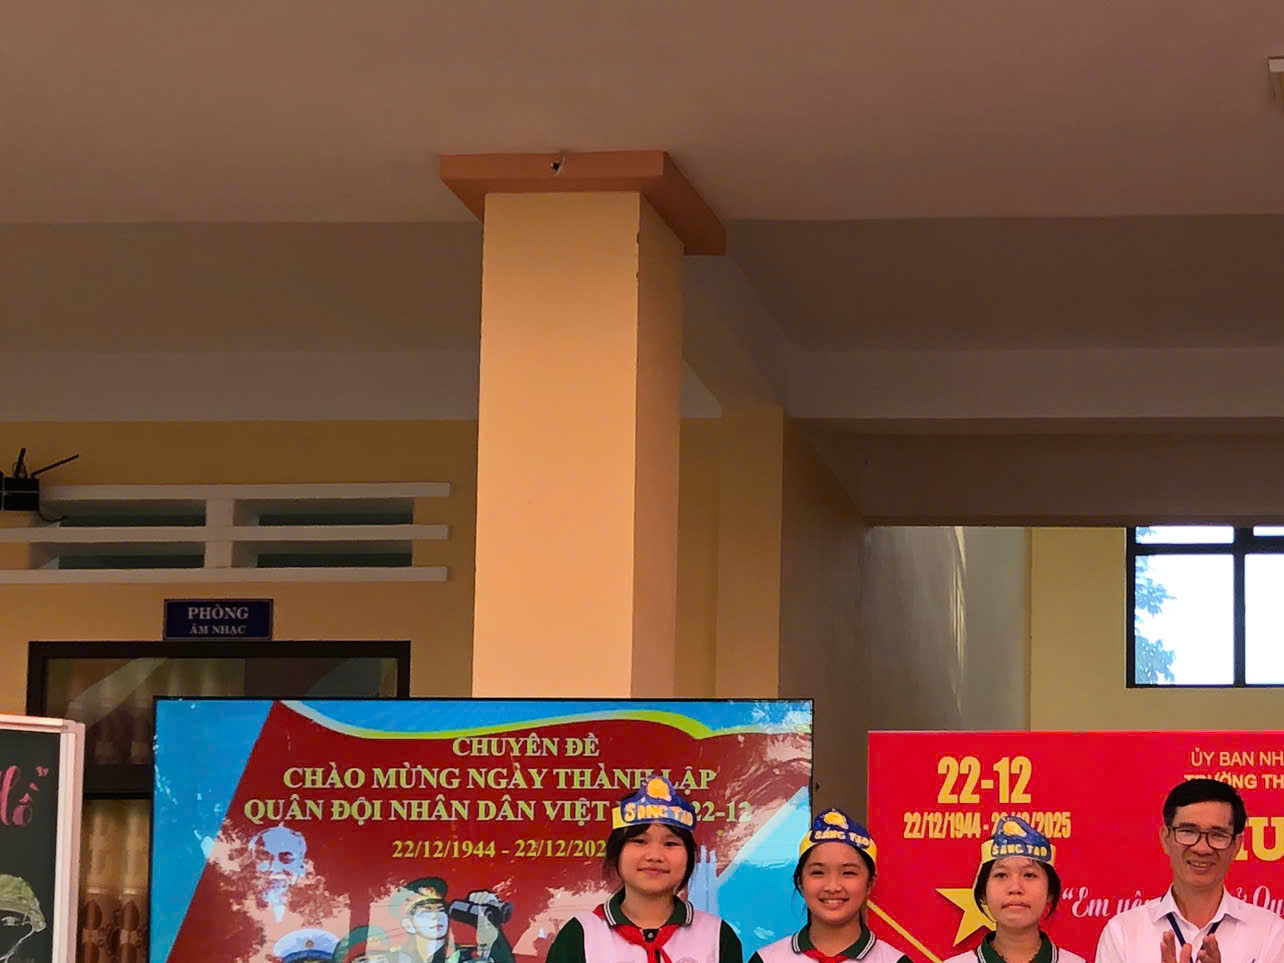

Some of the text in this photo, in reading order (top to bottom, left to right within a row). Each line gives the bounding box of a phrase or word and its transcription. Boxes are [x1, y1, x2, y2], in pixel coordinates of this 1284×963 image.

[188, 604, 248, 620] PHÒNG
[452, 732, 600, 757] CHUYÊN ĐỀ
[1191, 747, 1215, 767] ỦY
[1219, 751, 1255, 767] BAN
[283, 762, 365, 789] CHÀO
[372, 762, 460, 789] MỪNG
[466, 762, 547, 789] NGÀY
[937, 756, 1032, 804] 22-12
[244, 794, 323, 825] QUÂN
[330, 797, 383, 825] ĐỘI
[389, 794, 469, 821] NHÂN
[476, 794, 541, 821] DÂN
[543, 797, 610, 827] VIỆT
[904, 812, 981, 839] 22/12/1944
[392, 839, 496, 859] 22/12/1944
[515, 838, 606, 858] 22/12/202
